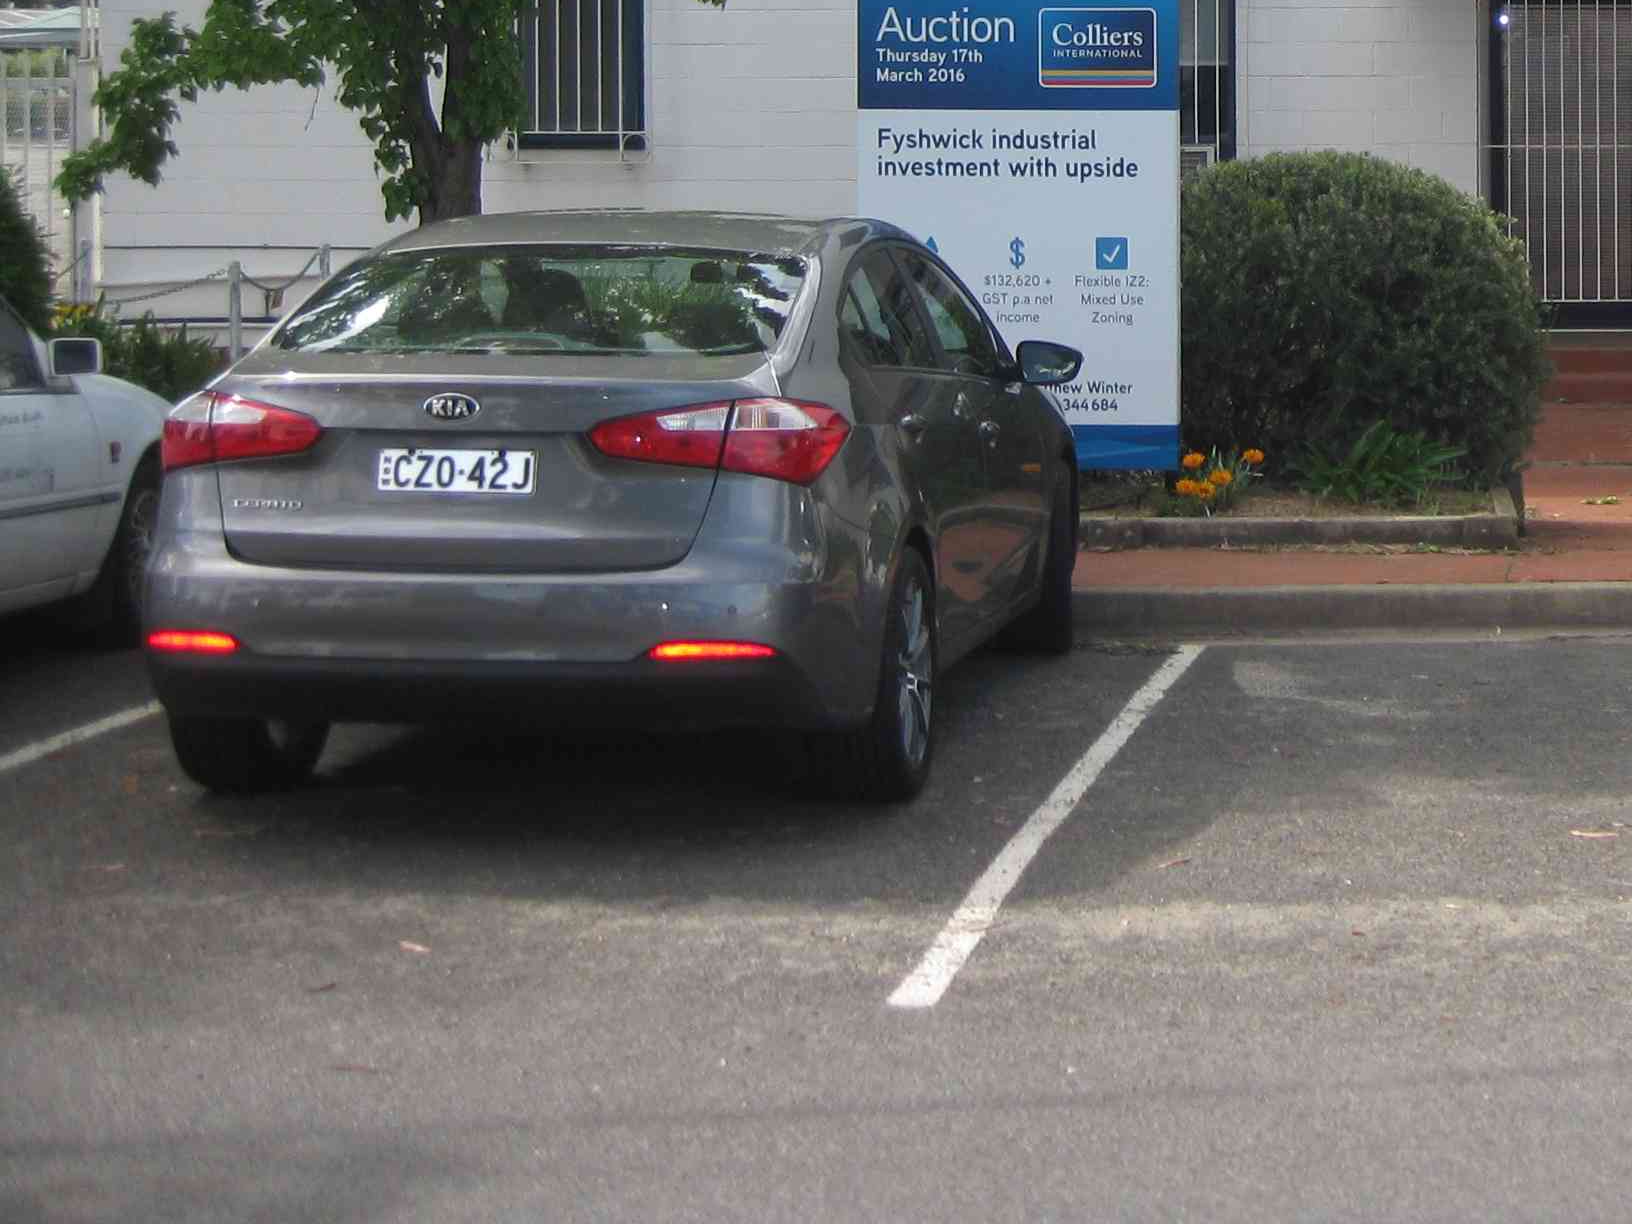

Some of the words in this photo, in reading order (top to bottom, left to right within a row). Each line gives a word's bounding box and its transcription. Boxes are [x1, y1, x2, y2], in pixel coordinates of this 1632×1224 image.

[876, 7, 1015, 42] Auction
[1052, 23, 1143, 46] Colliers
[876, 48, 946, 66] Thursday
[952, 49, 983, 63] 17th
[1053, 49, 1142, 58] INTERNATIONAL
[876, 68, 922, 82] March
[928, 68, 965, 82] 2016
[877, 128, 983, 154] Fyshwick
[992, 129, 1096, 150] industrial
[877, 156, 1000, 177] investment
[1008, 157, 1057, 177] with
[1066, 157, 1139, 183] upside
[983, 275, 1040, 288] $132,620
[1074, 275, 1121, 287] Flexible
[982, 293, 1008, 305] GST
[1034, 294, 1053, 305] net
[1080, 293, 1116, 305] Mixed
[1120, 293, 1144, 305] Use
[997, 311, 1040, 323] income
[1091, 312, 1133, 325] Zoning
[1087, 381, 1133, 394] Winter
[432, 399, 469, 416] KIA
